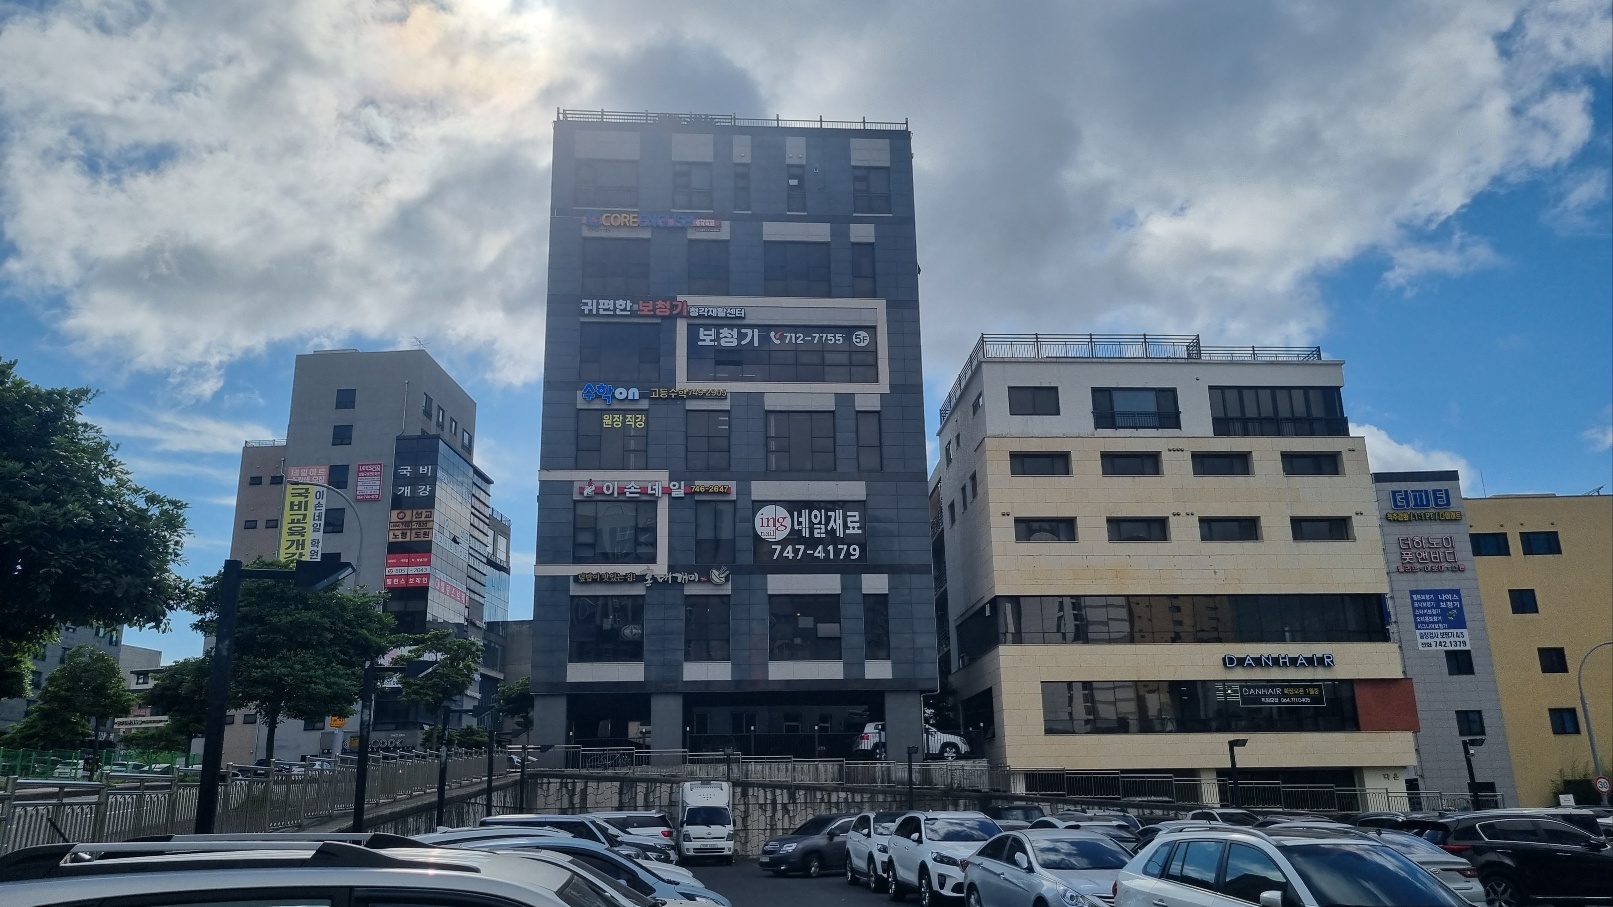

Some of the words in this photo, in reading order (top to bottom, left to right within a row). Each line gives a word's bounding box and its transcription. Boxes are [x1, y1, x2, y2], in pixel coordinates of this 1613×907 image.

[580, 299, 632, 315] 귀편한
[638, 300, 688, 316] 보청기
[689, 306, 745, 318] 청각재활센터
[697, 327, 759, 347] 보청기
[783, 333, 843, 344] 712-7755
[854, 332, 869, 345] 5F
[650, 388, 687, 398] 고등수학
[602, 414, 623, 428] 원장
[625, 414, 646, 428] 직강
[602, 481, 685, 498] 이손네일
[691, 485, 729, 493] 746-2647
[1390, 488, 1451, 509] 더피티
[759, 513, 788, 532] ing
[793, 509, 862, 538] 네일재료
[309, 538, 320, 560] 학원
[1398, 535, 1456, 549] 더하노이
[771, 544, 860, 560] 747-4179
[1401, 549, 1459, 563] 풋앤바디
[601, 572, 624, 582] 맛있는
[1438, 593, 1459, 601] 나이스
[1439, 601, 1460, 609] 보청기
[1433, 640, 1467, 648] 742.1379
[1224, 653, 1335, 668] DANHAIR
[1242, 687, 1282, 695] DANHAIR
[1597, 780, 1608, 790] 30
